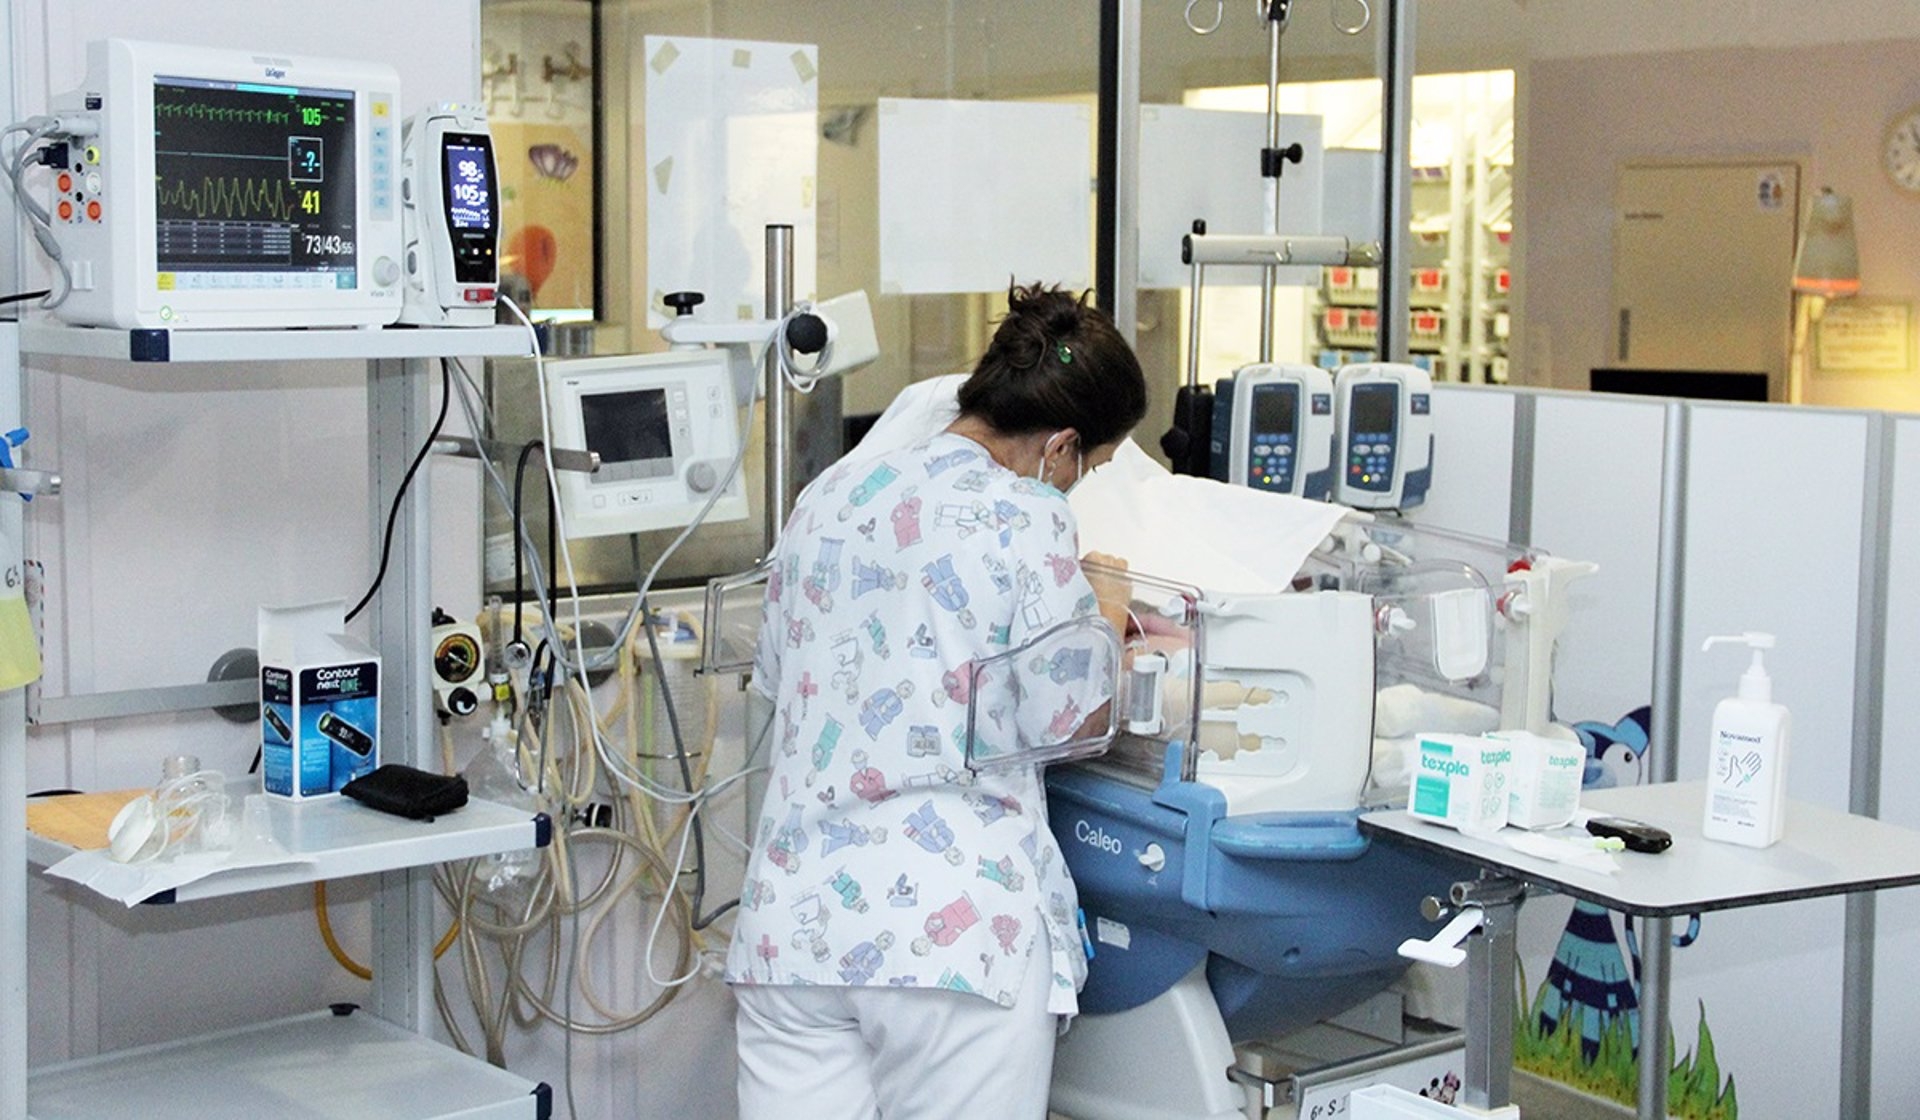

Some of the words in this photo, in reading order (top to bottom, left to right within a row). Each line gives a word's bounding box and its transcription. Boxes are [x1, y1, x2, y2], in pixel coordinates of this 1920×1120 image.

[302, 108, 321, 126] 105
[458, 160, 478, 177] 98
[453, 183, 479, 201] 105
[301, 190, 320, 214] 41
[316, 667, 361, 681] Contour
[316, 679, 340, 691] next
[1720, 730, 1762, 743] Novamed
[1421, 754, 1470, 777] texpla
[1075, 819, 1123, 854] Caleo
